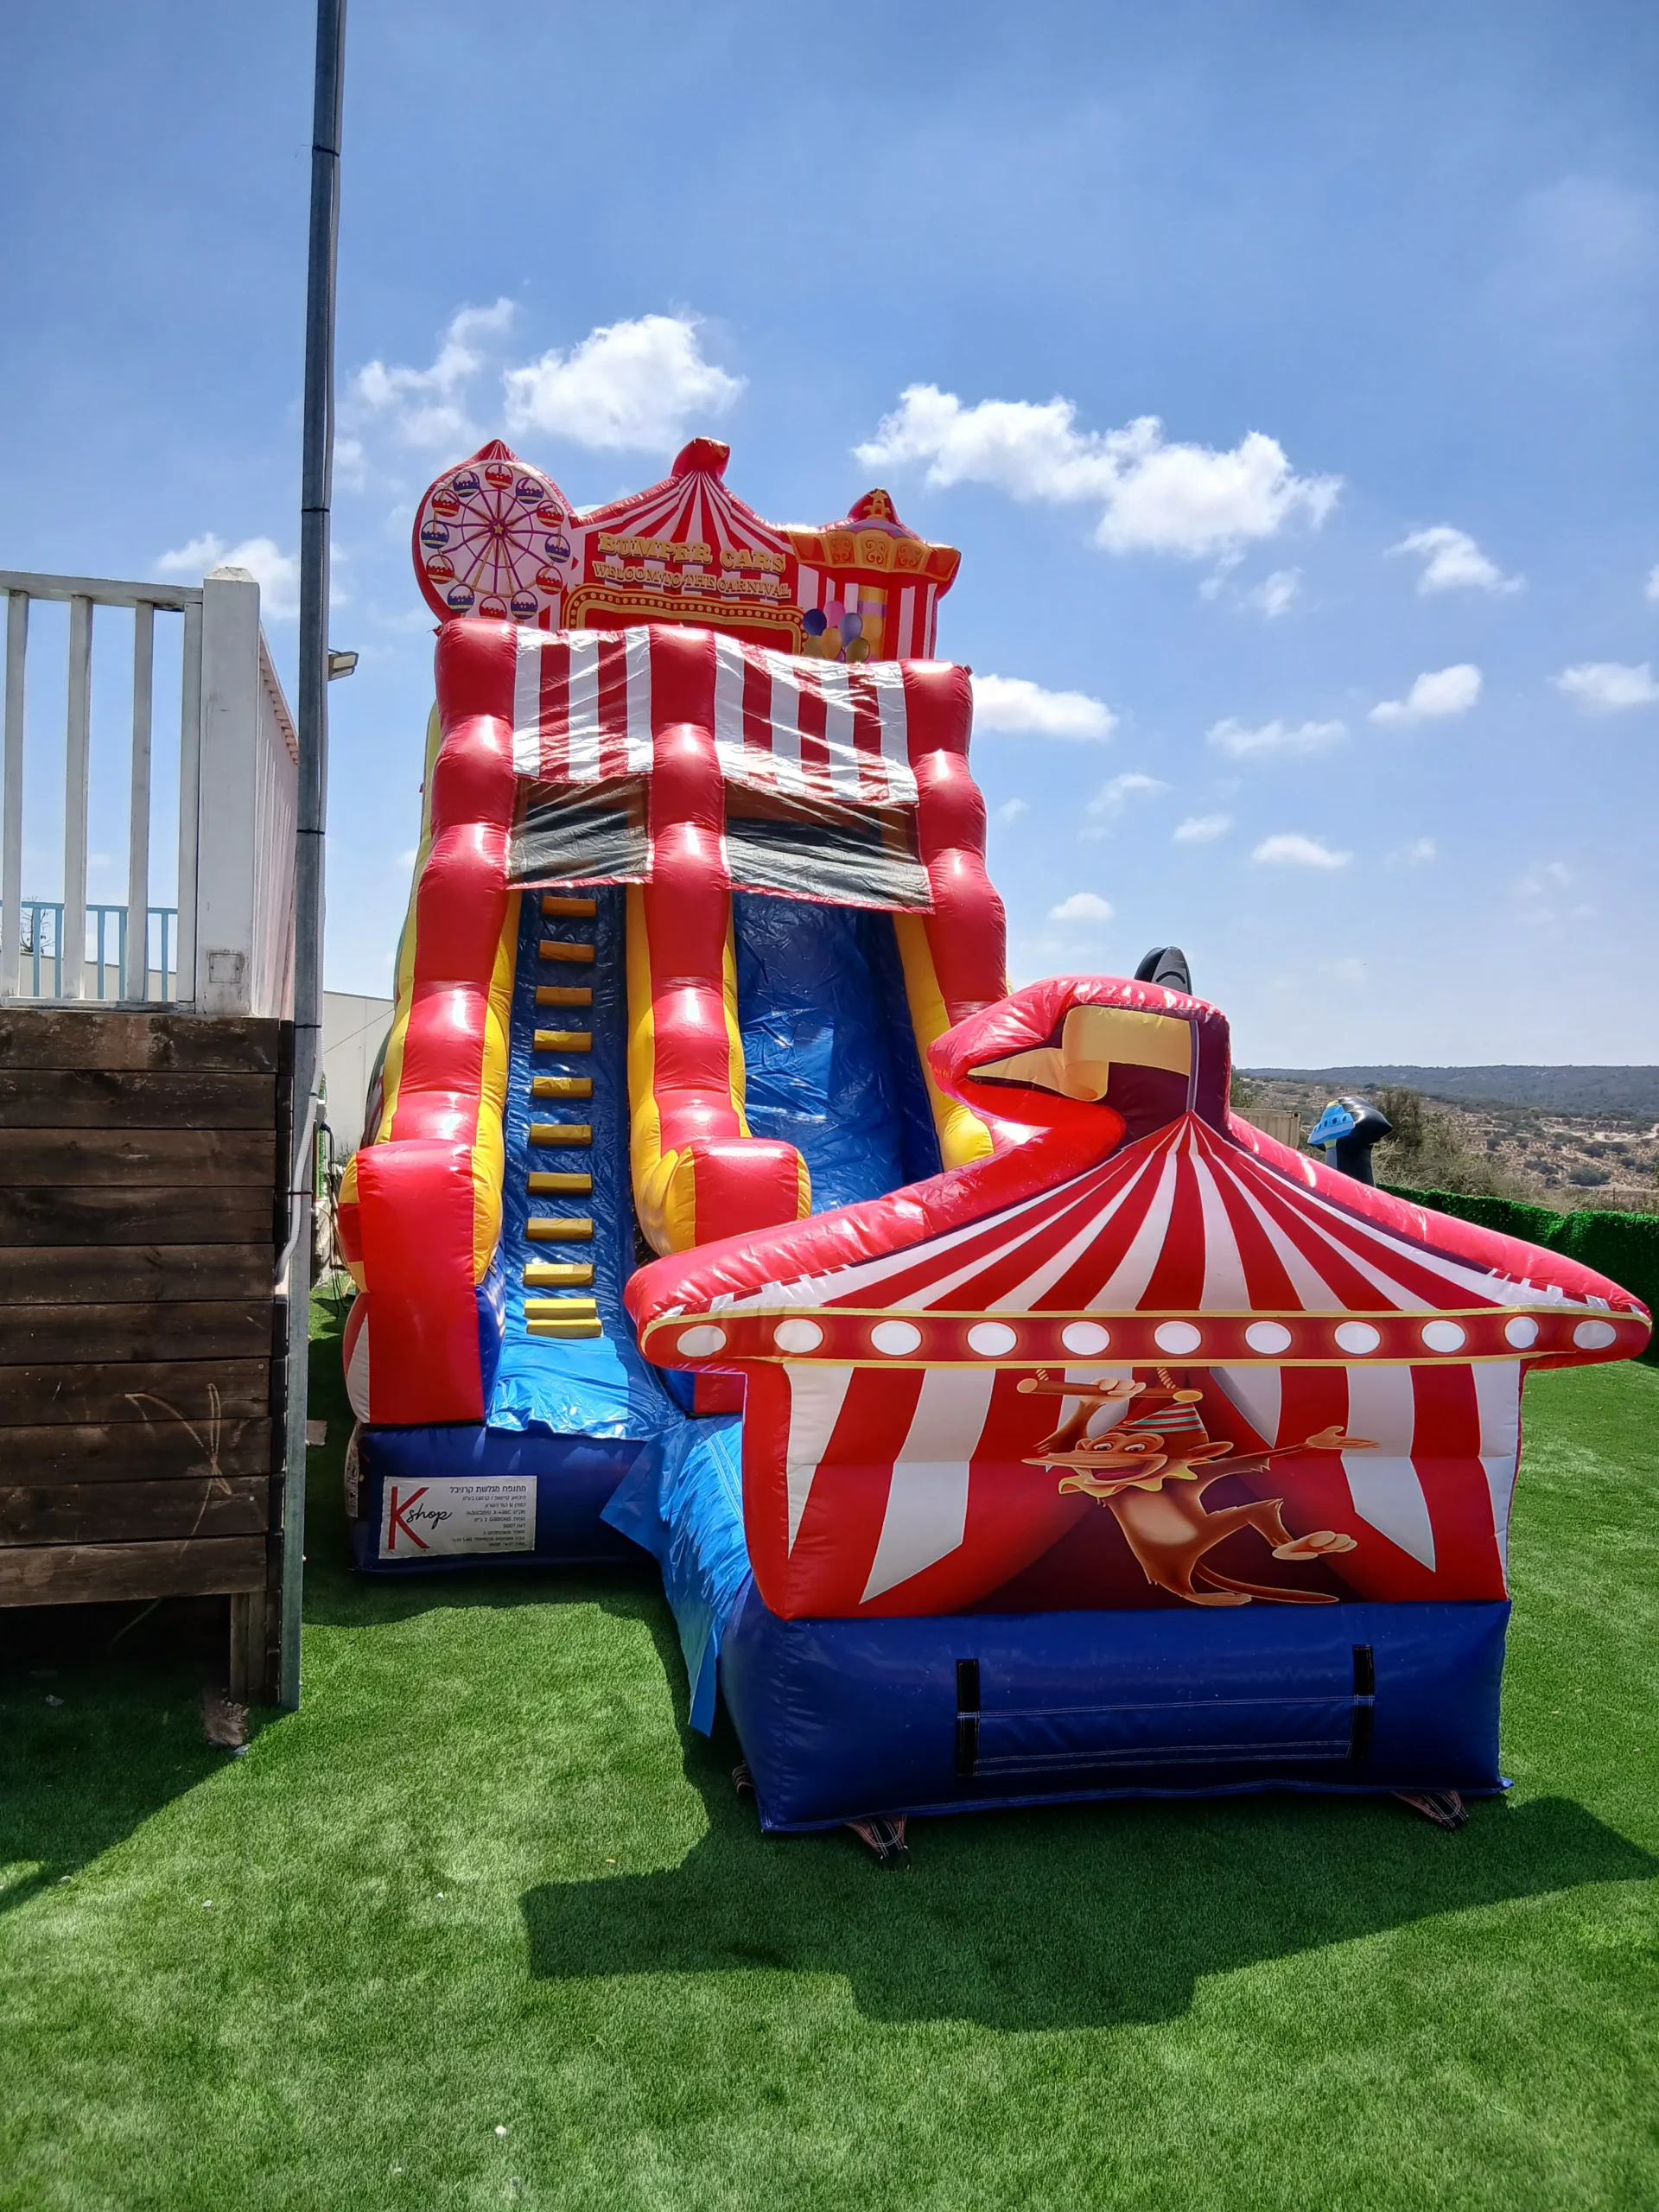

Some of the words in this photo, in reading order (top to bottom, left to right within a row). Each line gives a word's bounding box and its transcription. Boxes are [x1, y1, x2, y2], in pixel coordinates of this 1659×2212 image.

[598, 532, 713, 564] BUMPER
[720, 549, 785, 574] CARS
[661, 570, 682, 588] TO
[683, 574, 716, 591] THE
[717, 578, 791, 599] CARNIVAL
